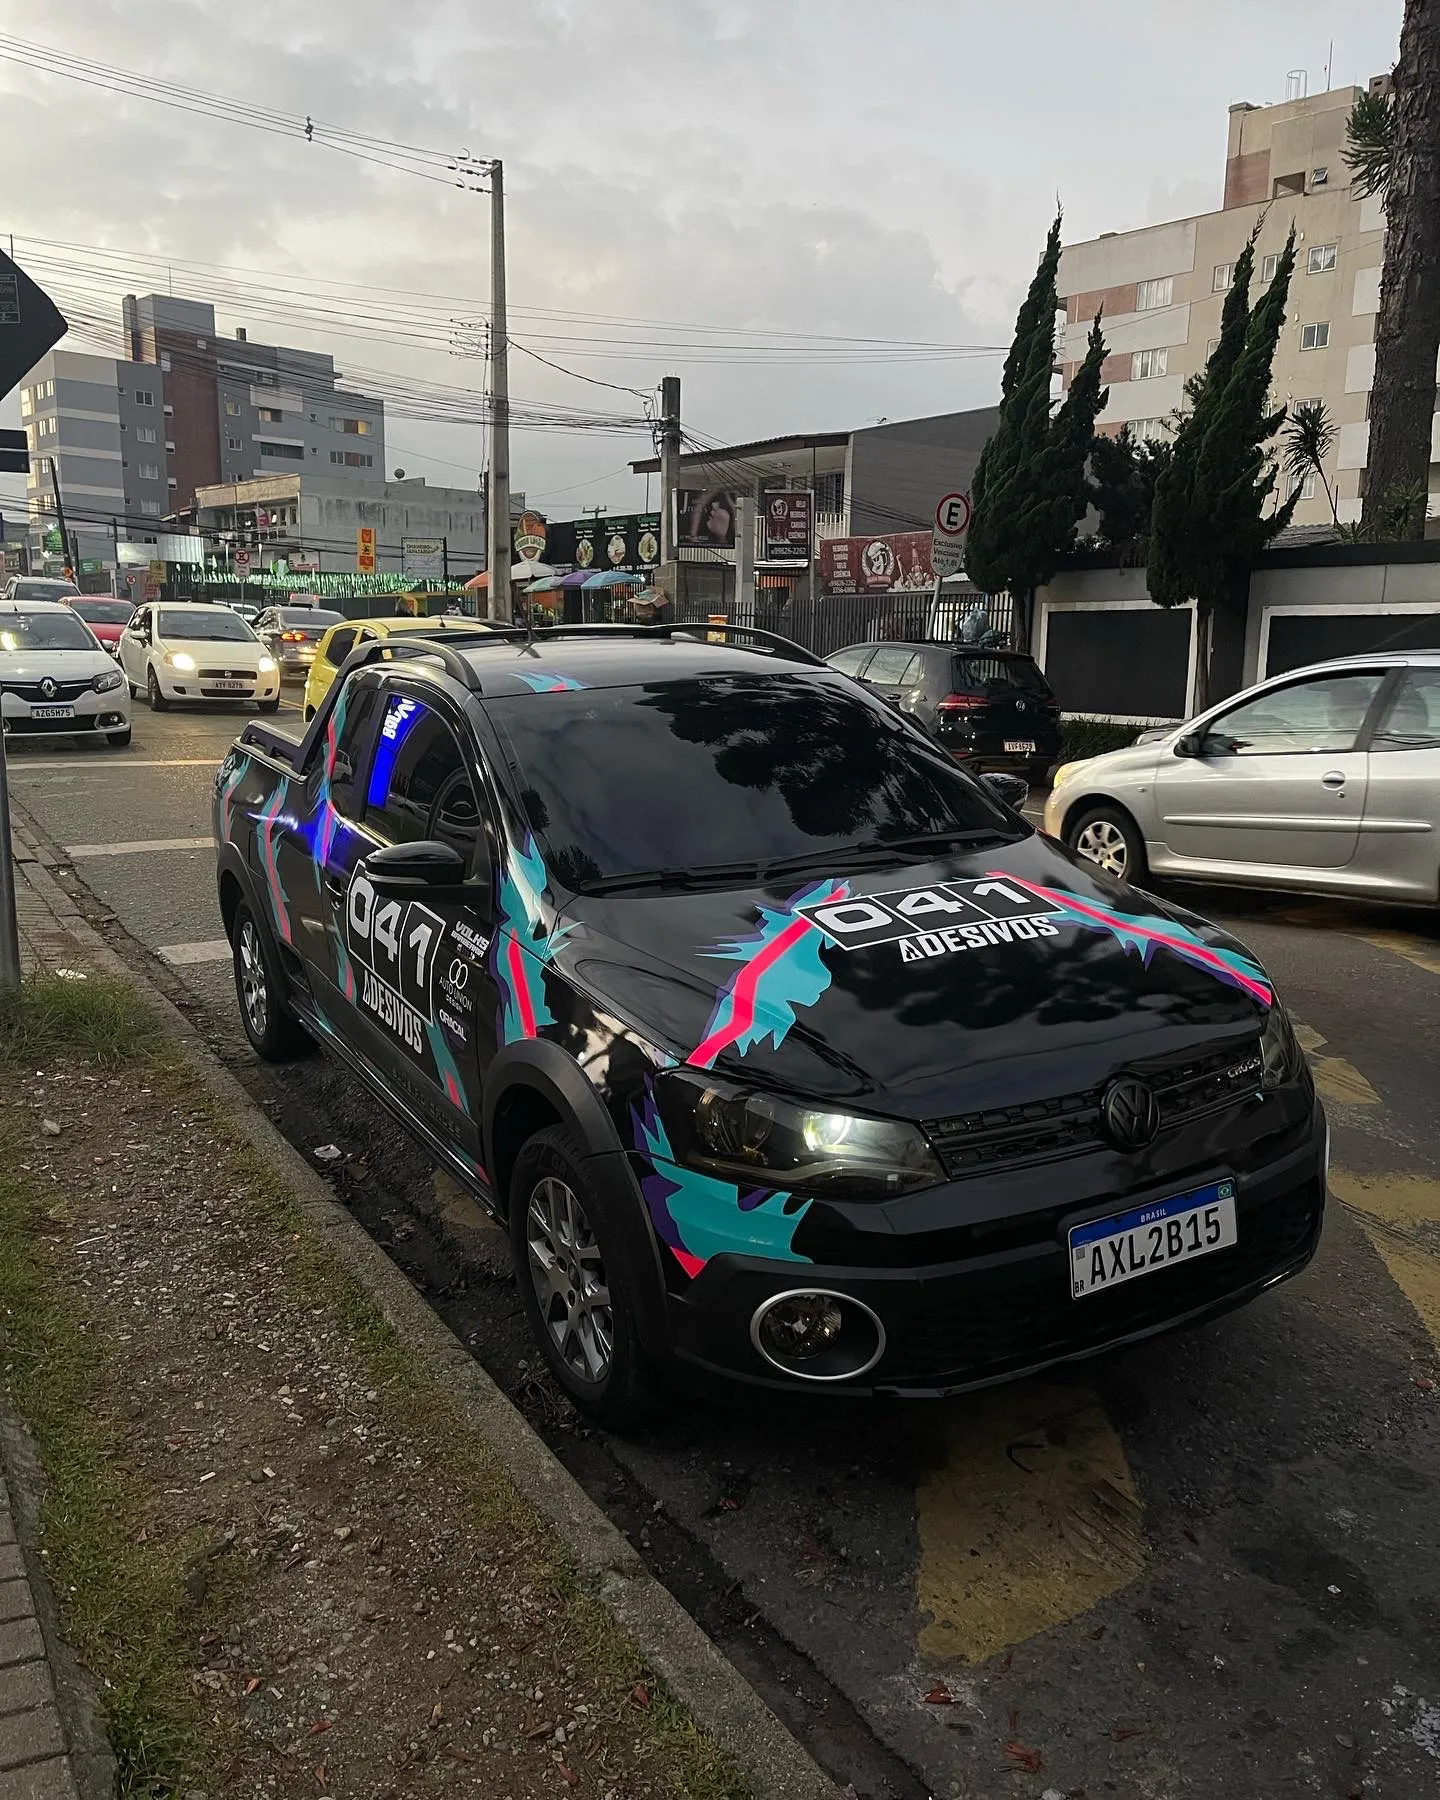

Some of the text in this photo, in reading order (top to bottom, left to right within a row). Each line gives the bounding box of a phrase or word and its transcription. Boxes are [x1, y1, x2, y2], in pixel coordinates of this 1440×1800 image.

[946, 502, 961, 526] E
[933, 538, 963, 550] Exclusivo
[35, 709, 71, 718] AZG5H75
[814, 882, 1031, 933] 041
[350, 876, 432, 988] 041
[899, 916, 1060, 962] ADESIVOS
[439, 976, 454, 995] AUTO
[363, 969, 423, 1055] ADESIVOS
[1140, 1208, 1168, 1223] BRASIL
[1090, 1206, 1221, 1286] AXL2B15
[1075, 1279, 1085, 1294] BR
